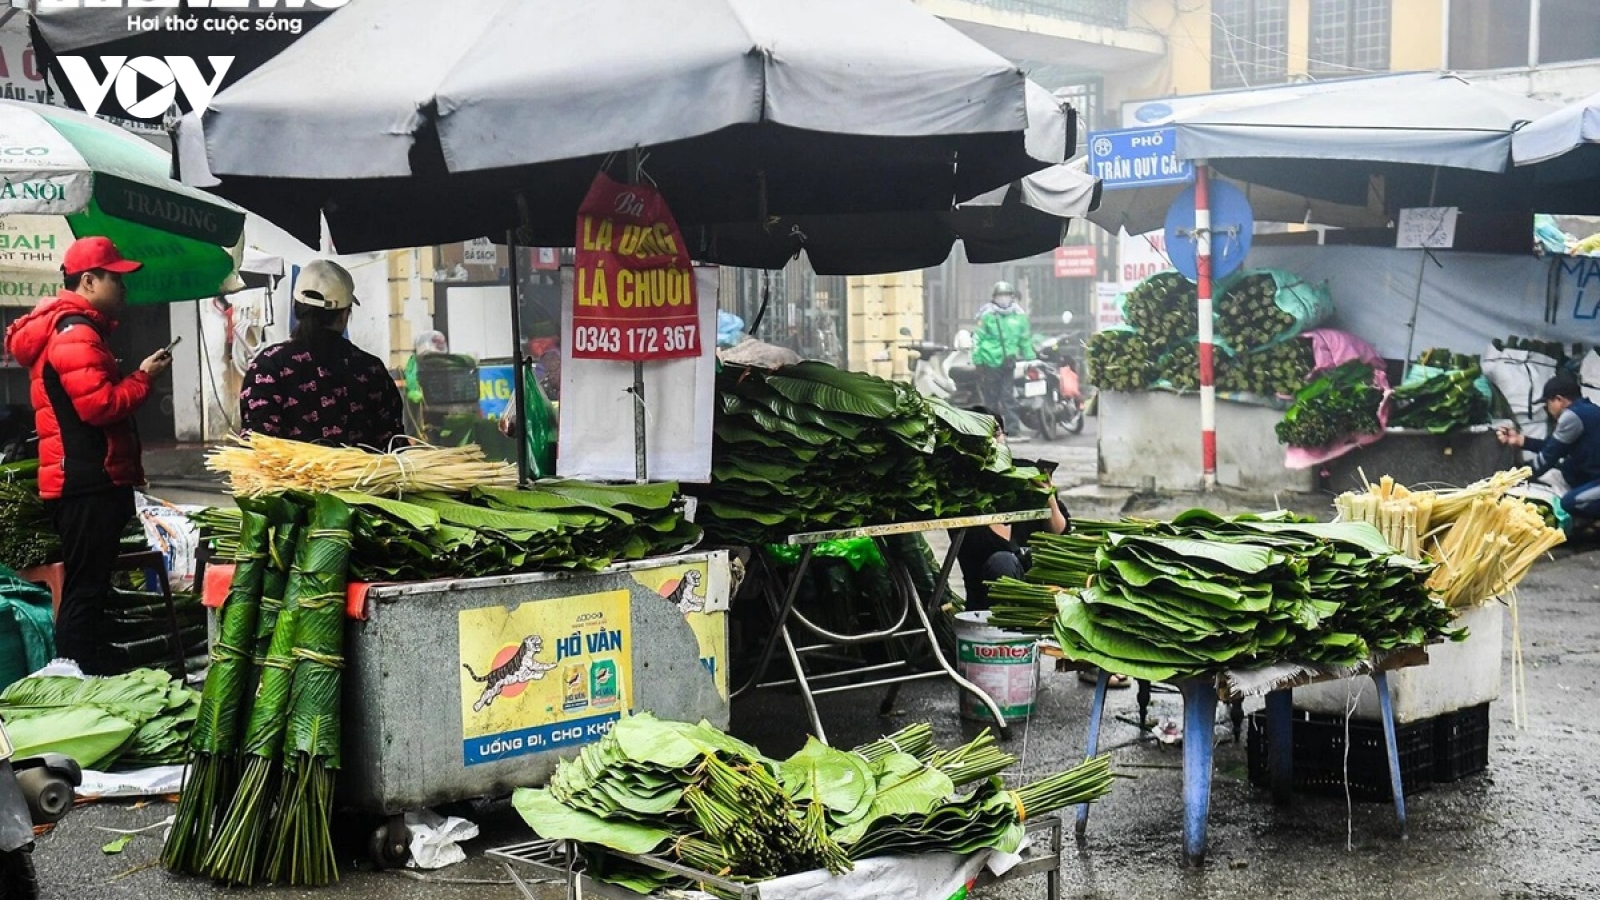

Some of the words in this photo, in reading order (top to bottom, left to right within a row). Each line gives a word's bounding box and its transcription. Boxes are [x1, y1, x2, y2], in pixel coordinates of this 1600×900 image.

[1131, 131, 1164, 148] PHỐ
[123, 188, 218, 233] TRADING
[578, 260, 609, 308] LÁ
[616, 257, 693, 309] CHUỐI
[575, 326, 621, 353] 0343
[626, 328, 659, 353] 172
[663, 325, 696, 350] 367
[480, 737, 523, 756] UỐNG
[551, 726, 582, 742] CHO
